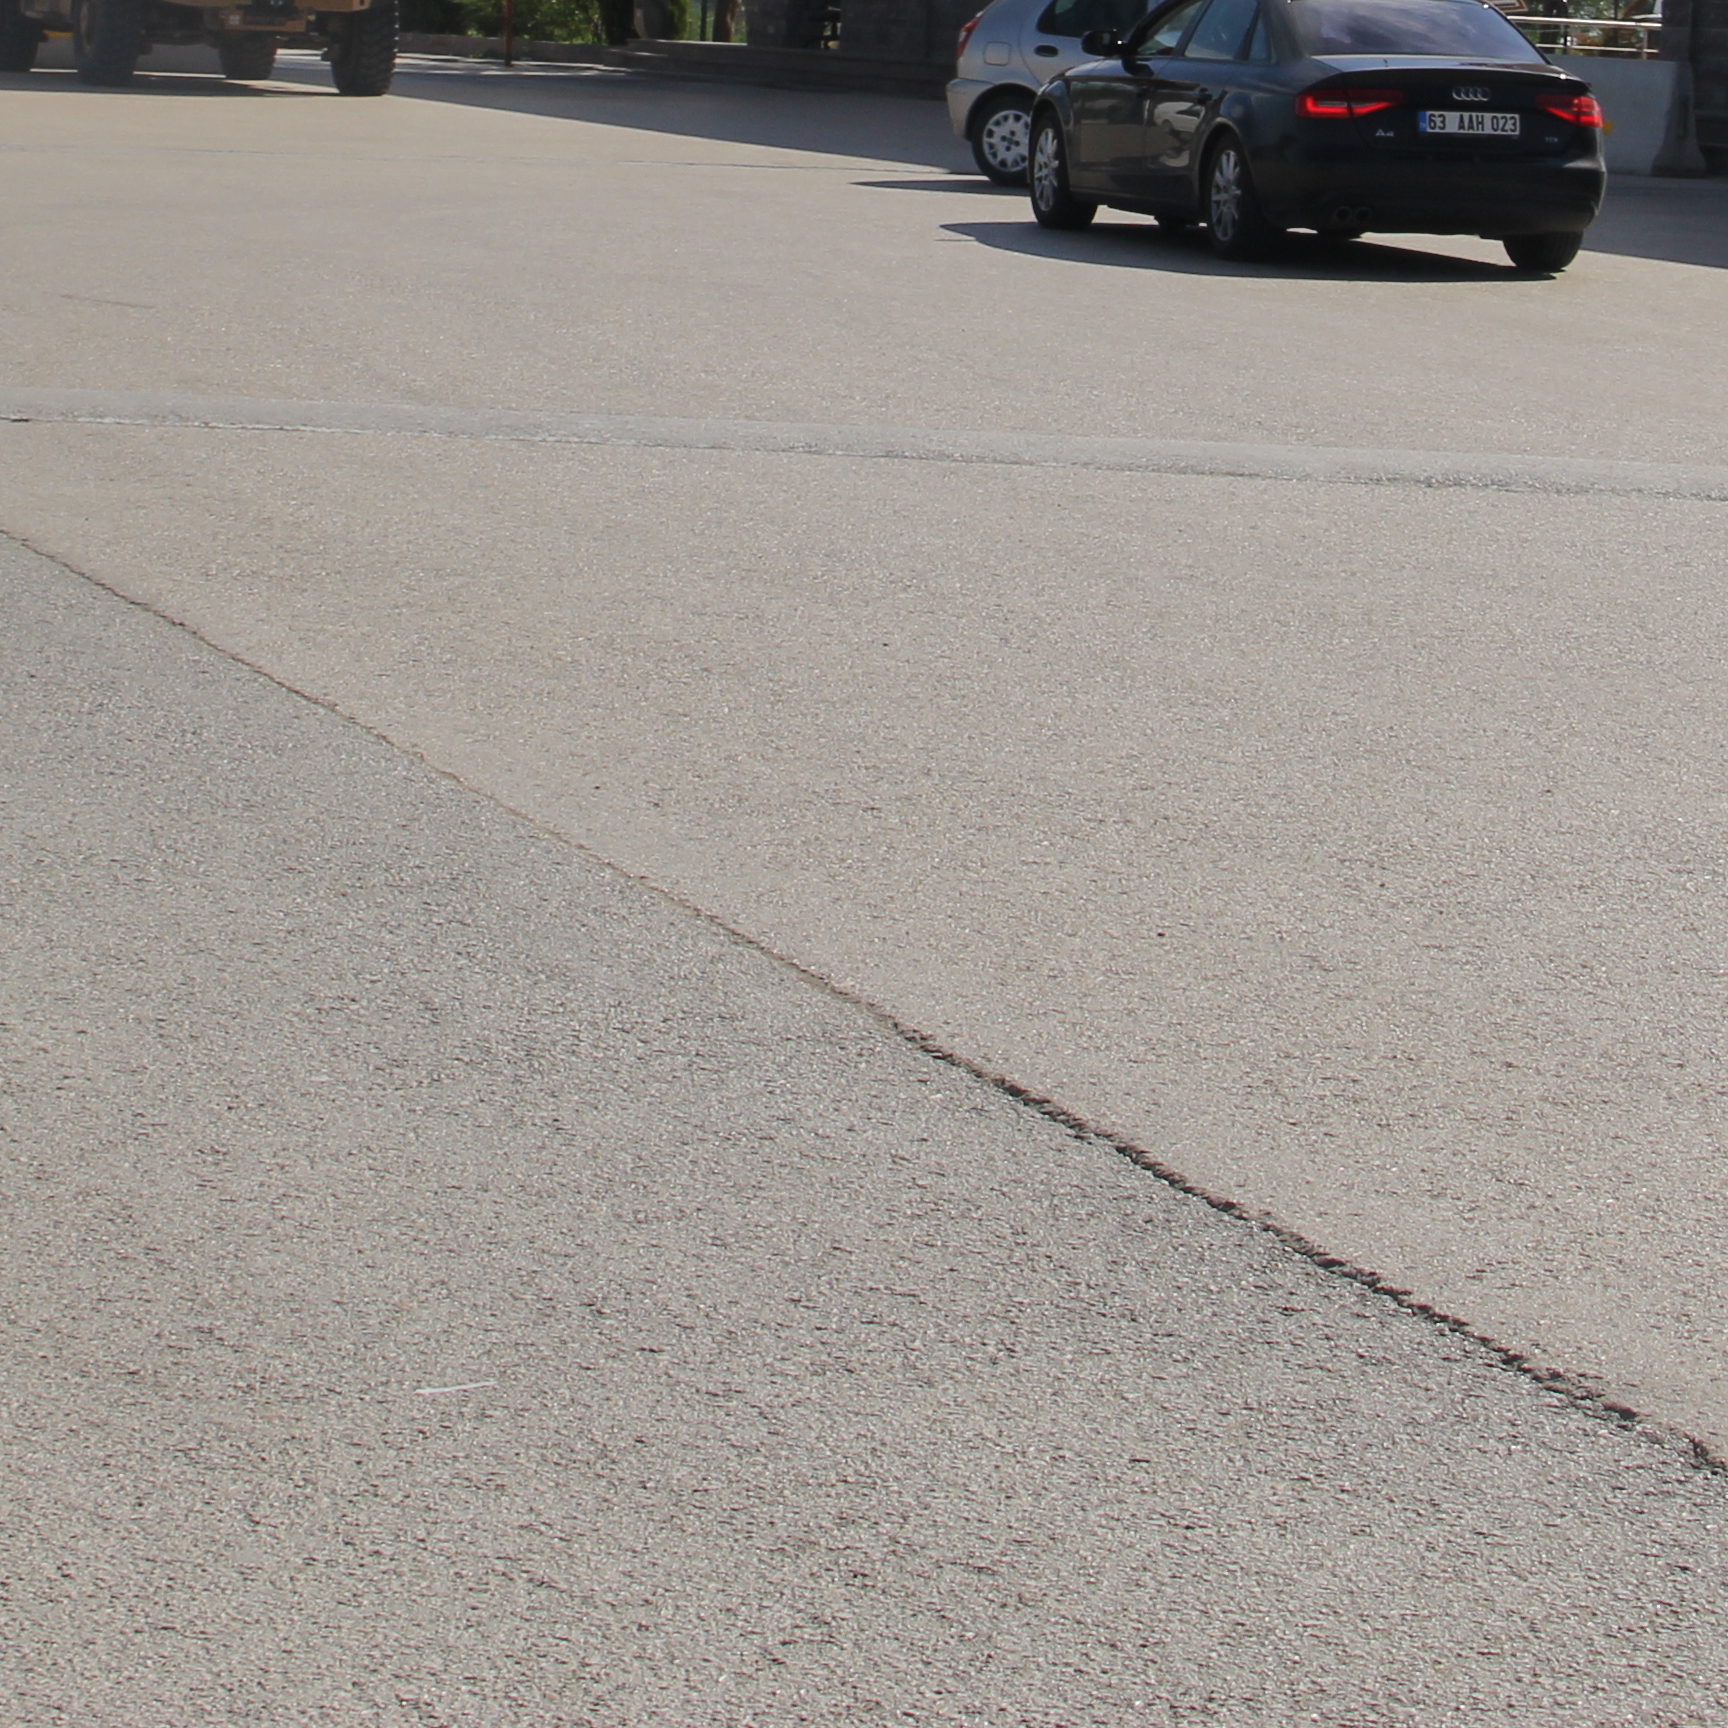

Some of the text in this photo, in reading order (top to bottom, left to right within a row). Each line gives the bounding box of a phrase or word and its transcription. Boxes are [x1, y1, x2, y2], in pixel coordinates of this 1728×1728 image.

[1427, 113, 1518, 133] 63 AAH 023
